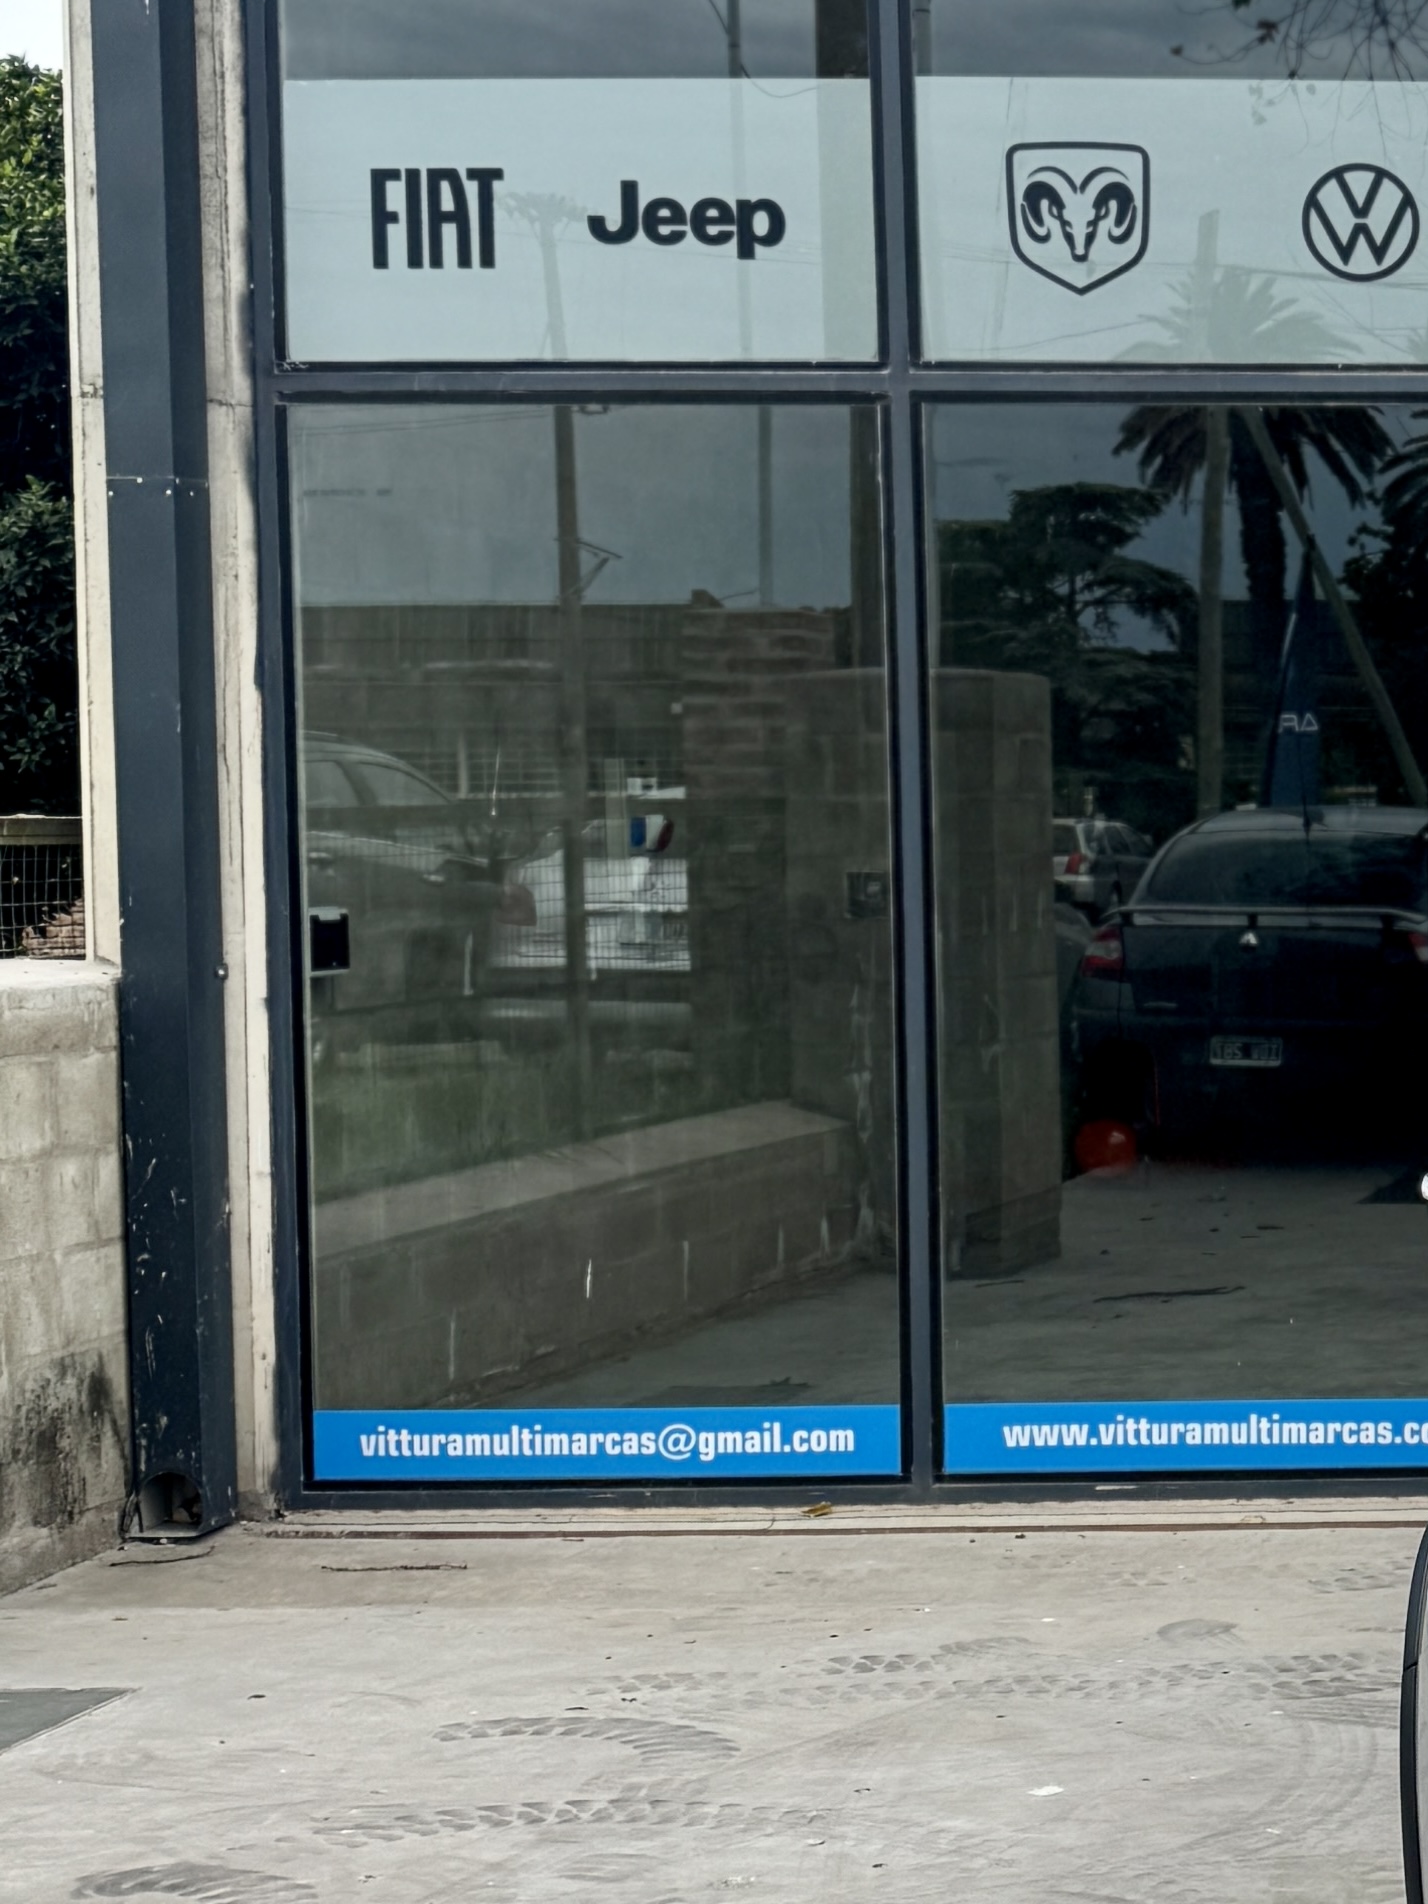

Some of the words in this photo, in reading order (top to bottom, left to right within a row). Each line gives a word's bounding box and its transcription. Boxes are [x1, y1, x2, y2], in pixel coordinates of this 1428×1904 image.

[370, 167, 504, 270] FIAT
[587, 179, 786, 260] Jeep
[359, 1422, 856, 1462] vitturamultimarcas@gmail.com
